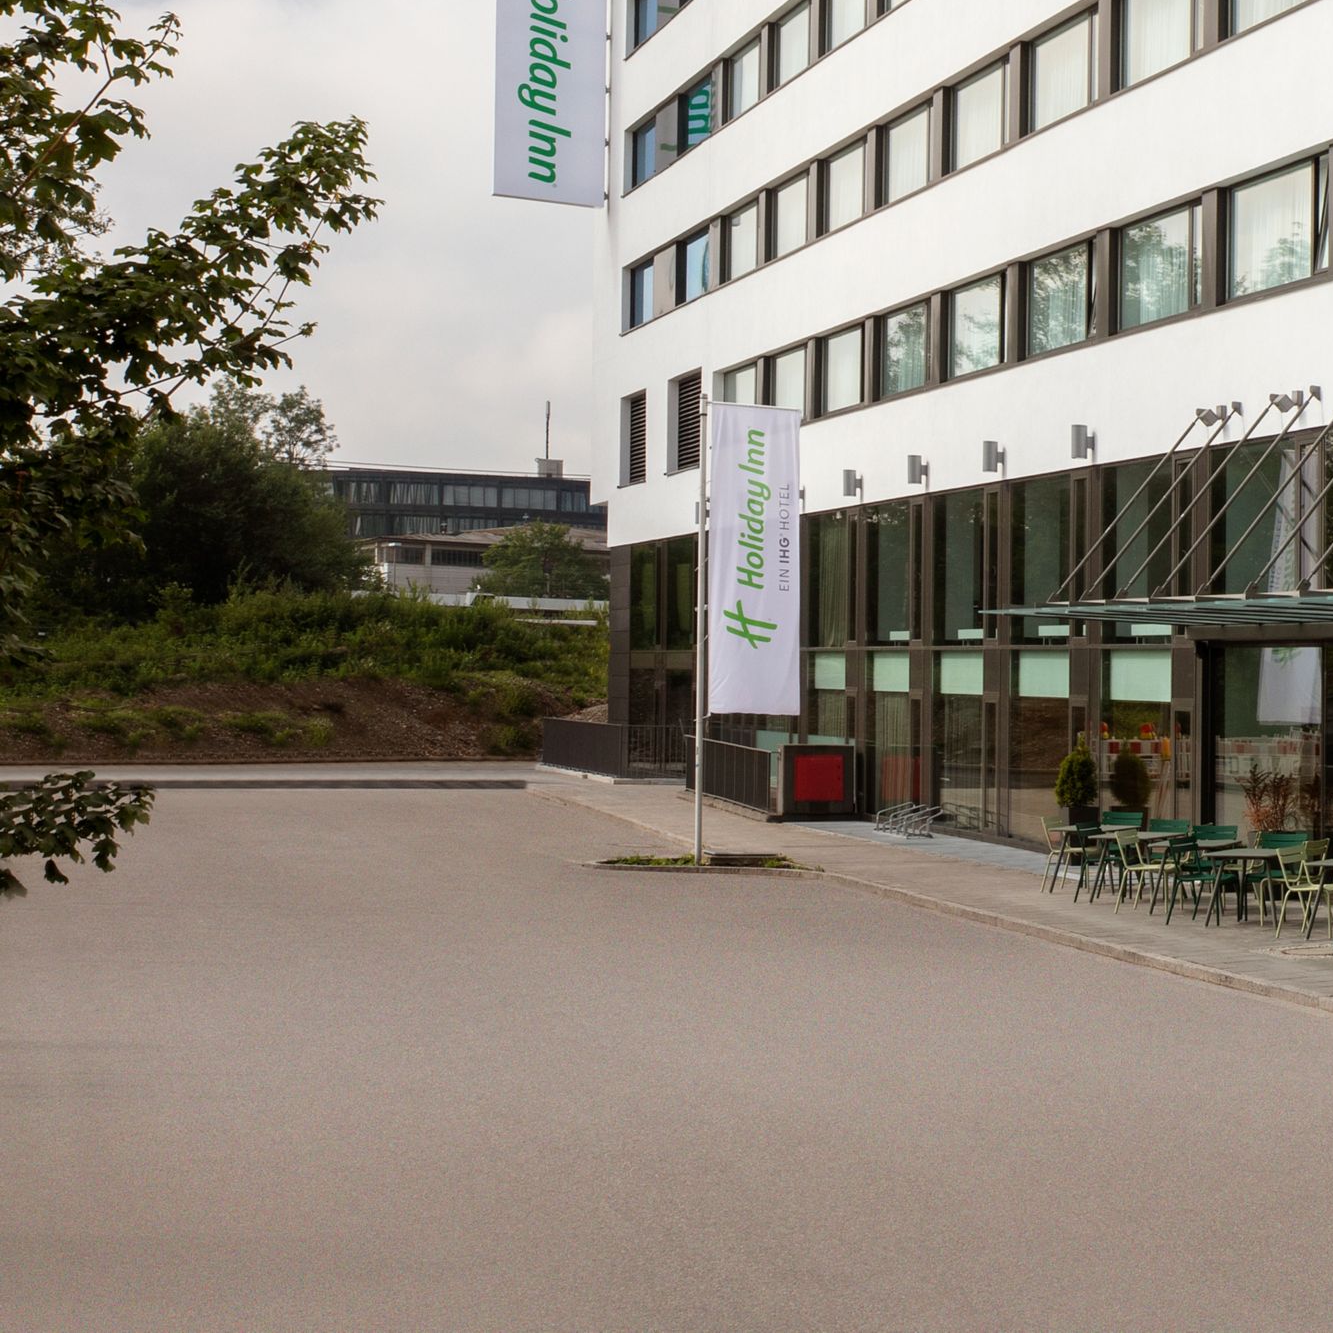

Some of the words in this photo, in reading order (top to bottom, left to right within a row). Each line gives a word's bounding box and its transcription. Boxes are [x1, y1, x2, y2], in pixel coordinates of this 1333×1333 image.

[527, 118, 573, 185] Inn
[737, 427, 767, 476] Inn
[778, 483, 790, 531] HOTEL
[736, 480, 772, 590] Holiday
[778, 567, 790, 592] EIN
